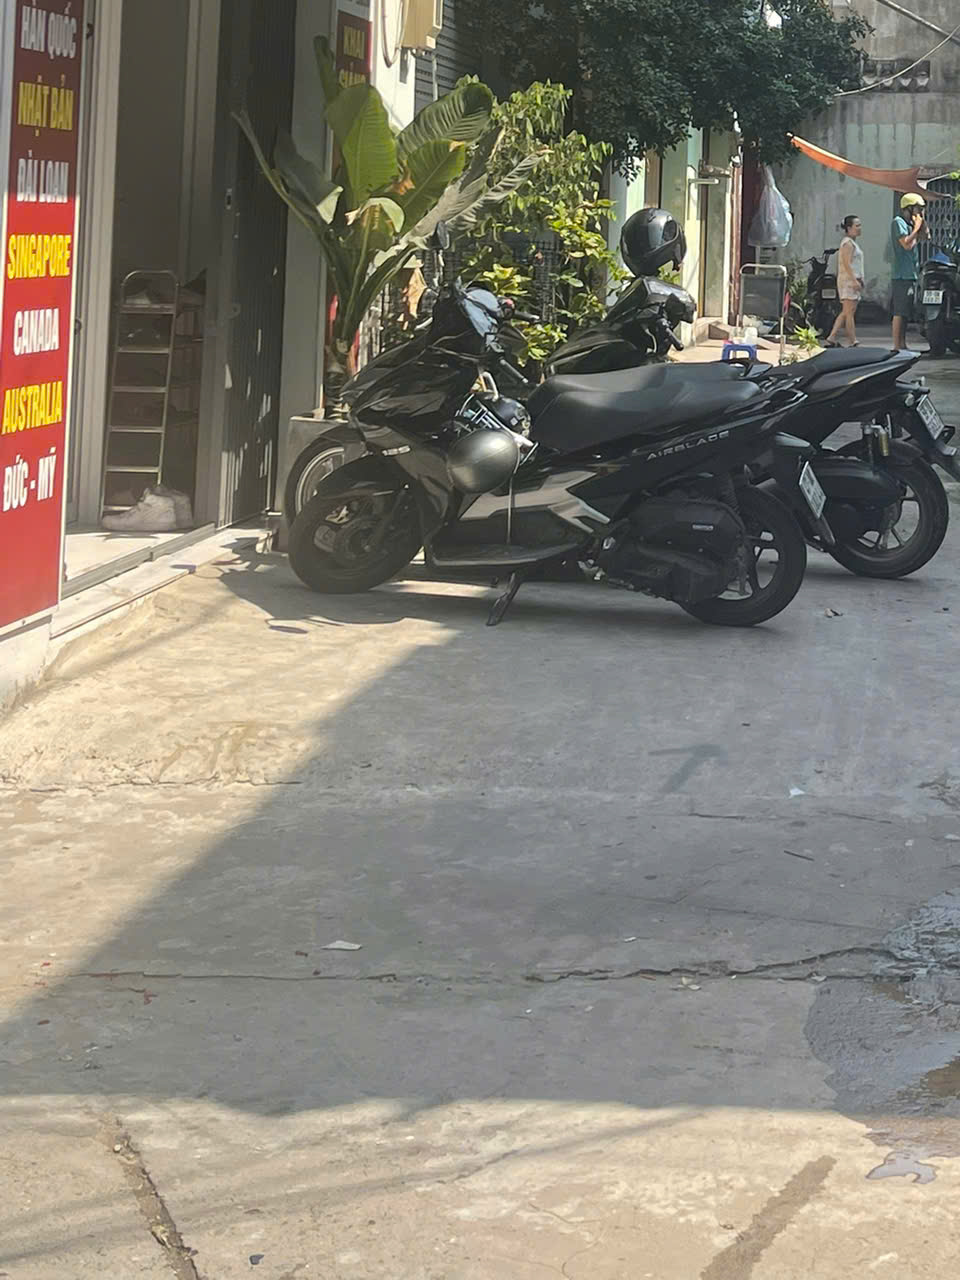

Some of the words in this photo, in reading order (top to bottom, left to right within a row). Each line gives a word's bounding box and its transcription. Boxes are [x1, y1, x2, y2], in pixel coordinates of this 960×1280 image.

[48, 1, 77, 60] QUỐC
[17, 75, 49, 137] NHẬT
[50, 74, 74, 131] BẢN
[17, 149, 38, 202] ĐÀI
[39, 160, 69, 204] LOAN
[7, 233, 72, 280] SINGAPORE
[13, 307, 60, 356] CANADA
[1, 381, 63, 435] AUSTRALIA
[3, 454, 29, 512] ĐỨC
[37, 447, 57, 501] MỸ
